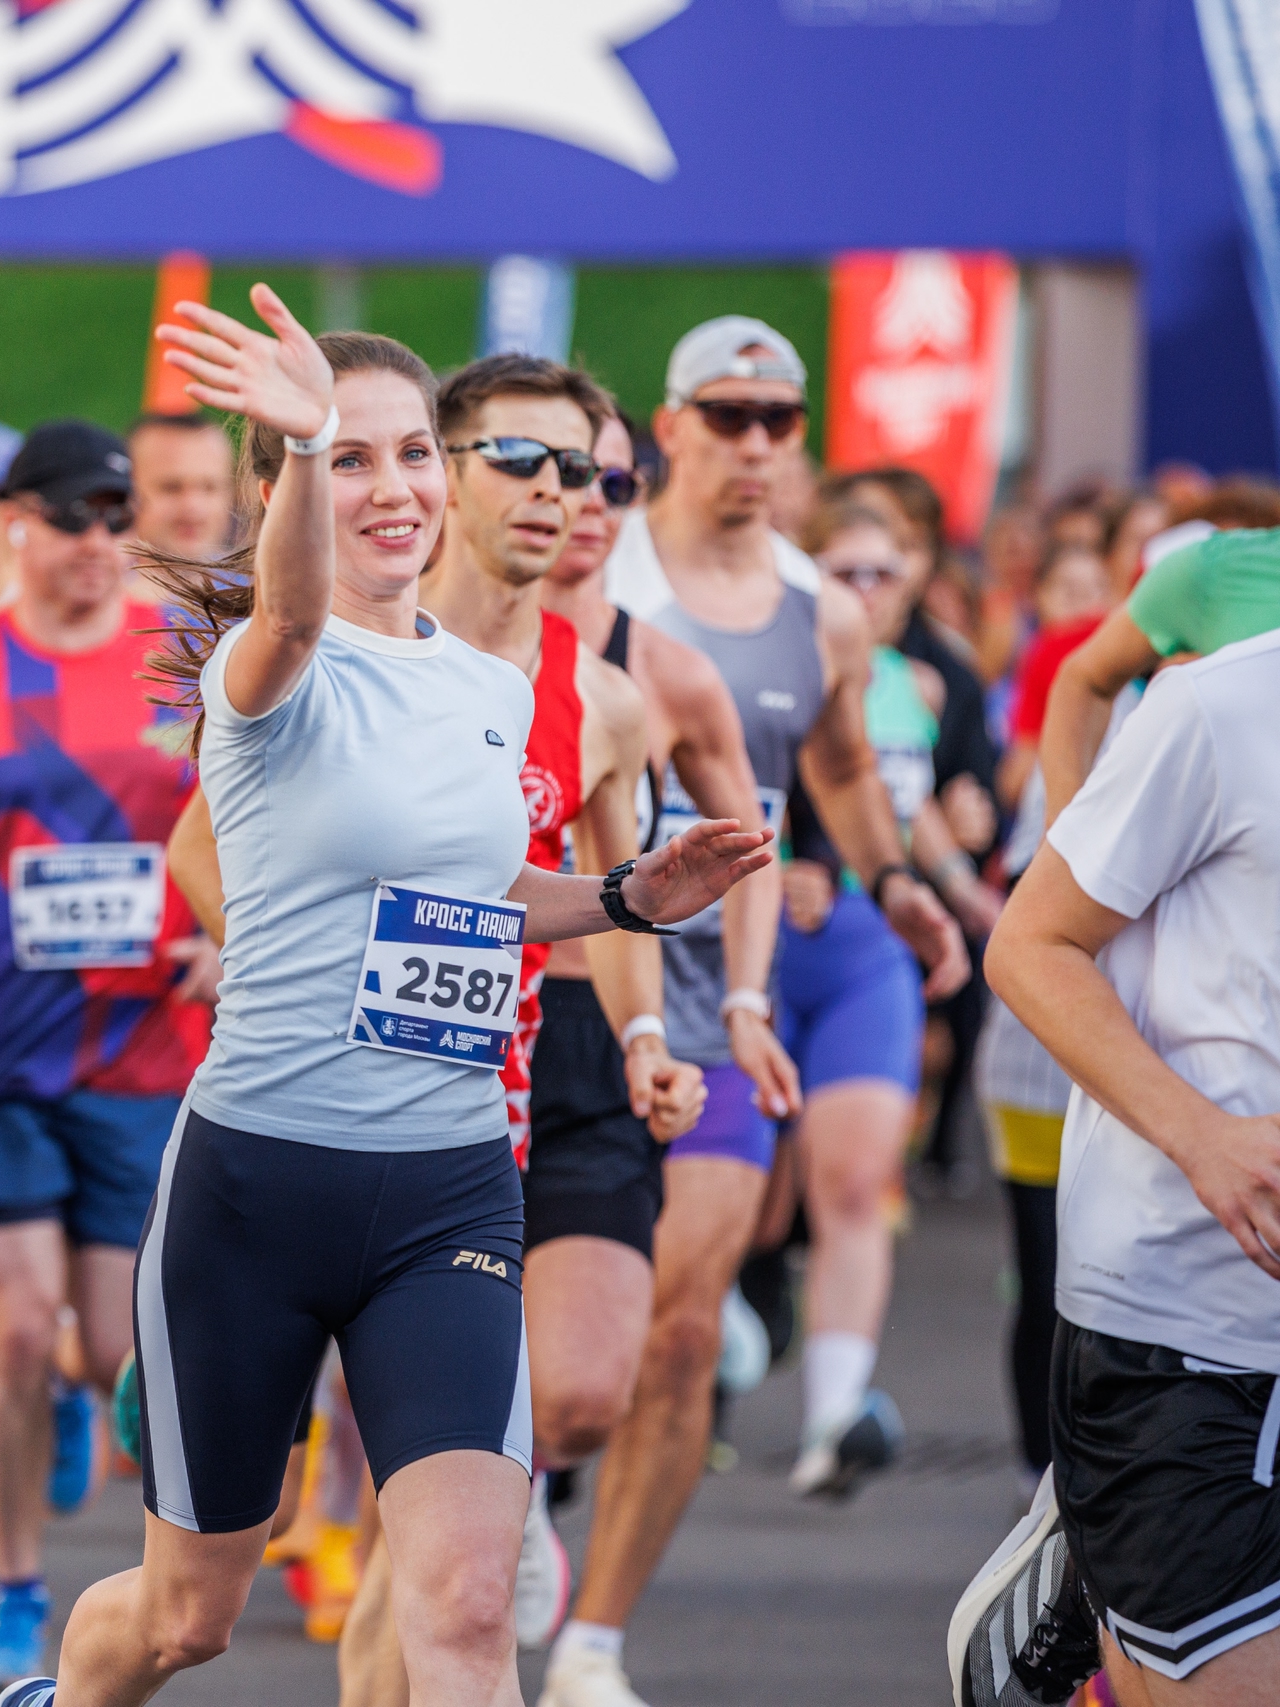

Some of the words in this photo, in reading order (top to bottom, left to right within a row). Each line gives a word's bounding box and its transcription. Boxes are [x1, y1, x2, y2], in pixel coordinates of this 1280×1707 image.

[414, 899, 473, 933] КРОСС
[476, 911, 521, 942] НАЦИИ
[396, 957, 514, 1017] 2587
[452, 1250, 507, 1278] FILA
